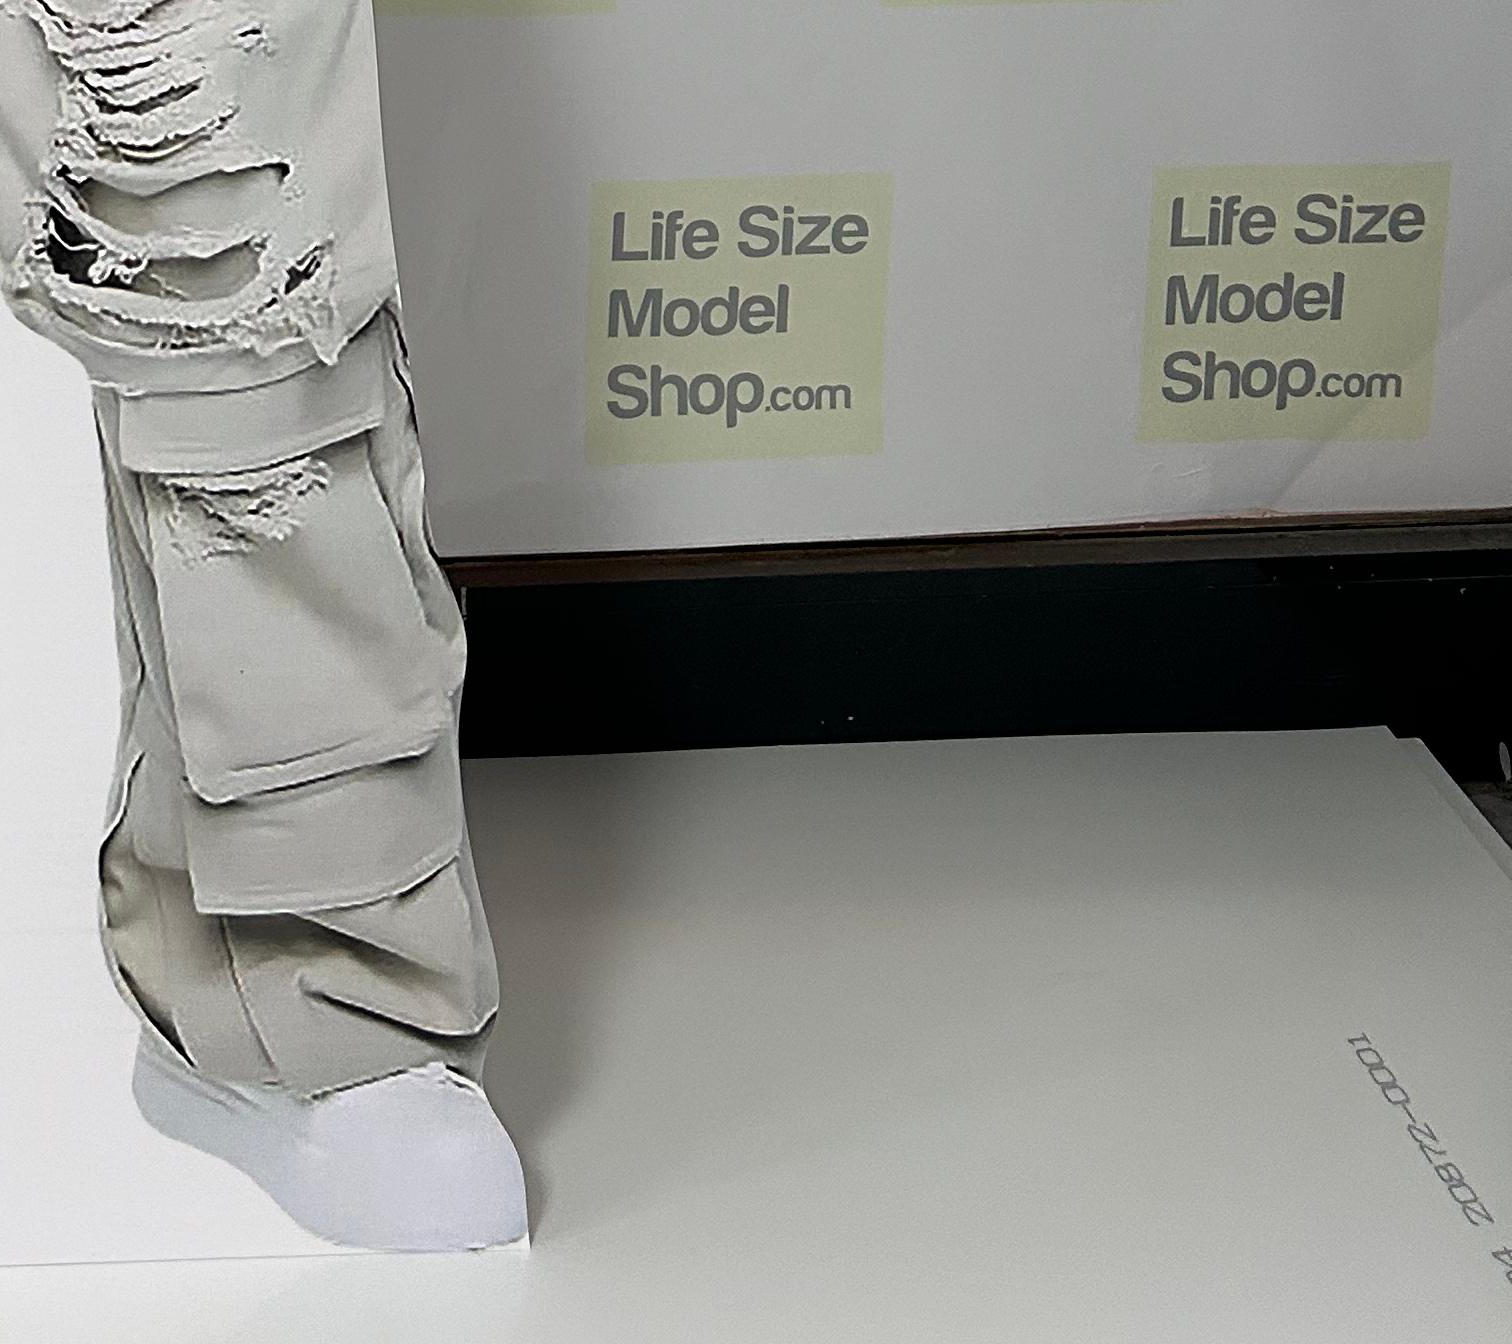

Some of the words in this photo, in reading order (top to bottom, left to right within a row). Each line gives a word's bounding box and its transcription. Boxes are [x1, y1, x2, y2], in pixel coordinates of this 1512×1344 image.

[611, 211, 719, 261] Life
[738, 205, 868, 257] Size
[1170, 195, 1276, 247] Life
[1295, 194, 1425, 244] Size
[608, 284, 789, 338] Model
[1165, 272, 1345, 325] Model
[606, 364, 851, 428] Shop.com
[1162, 351, 1402, 410] Shop.com
[1347, 1031, 1495, 1227] 20872-0001
